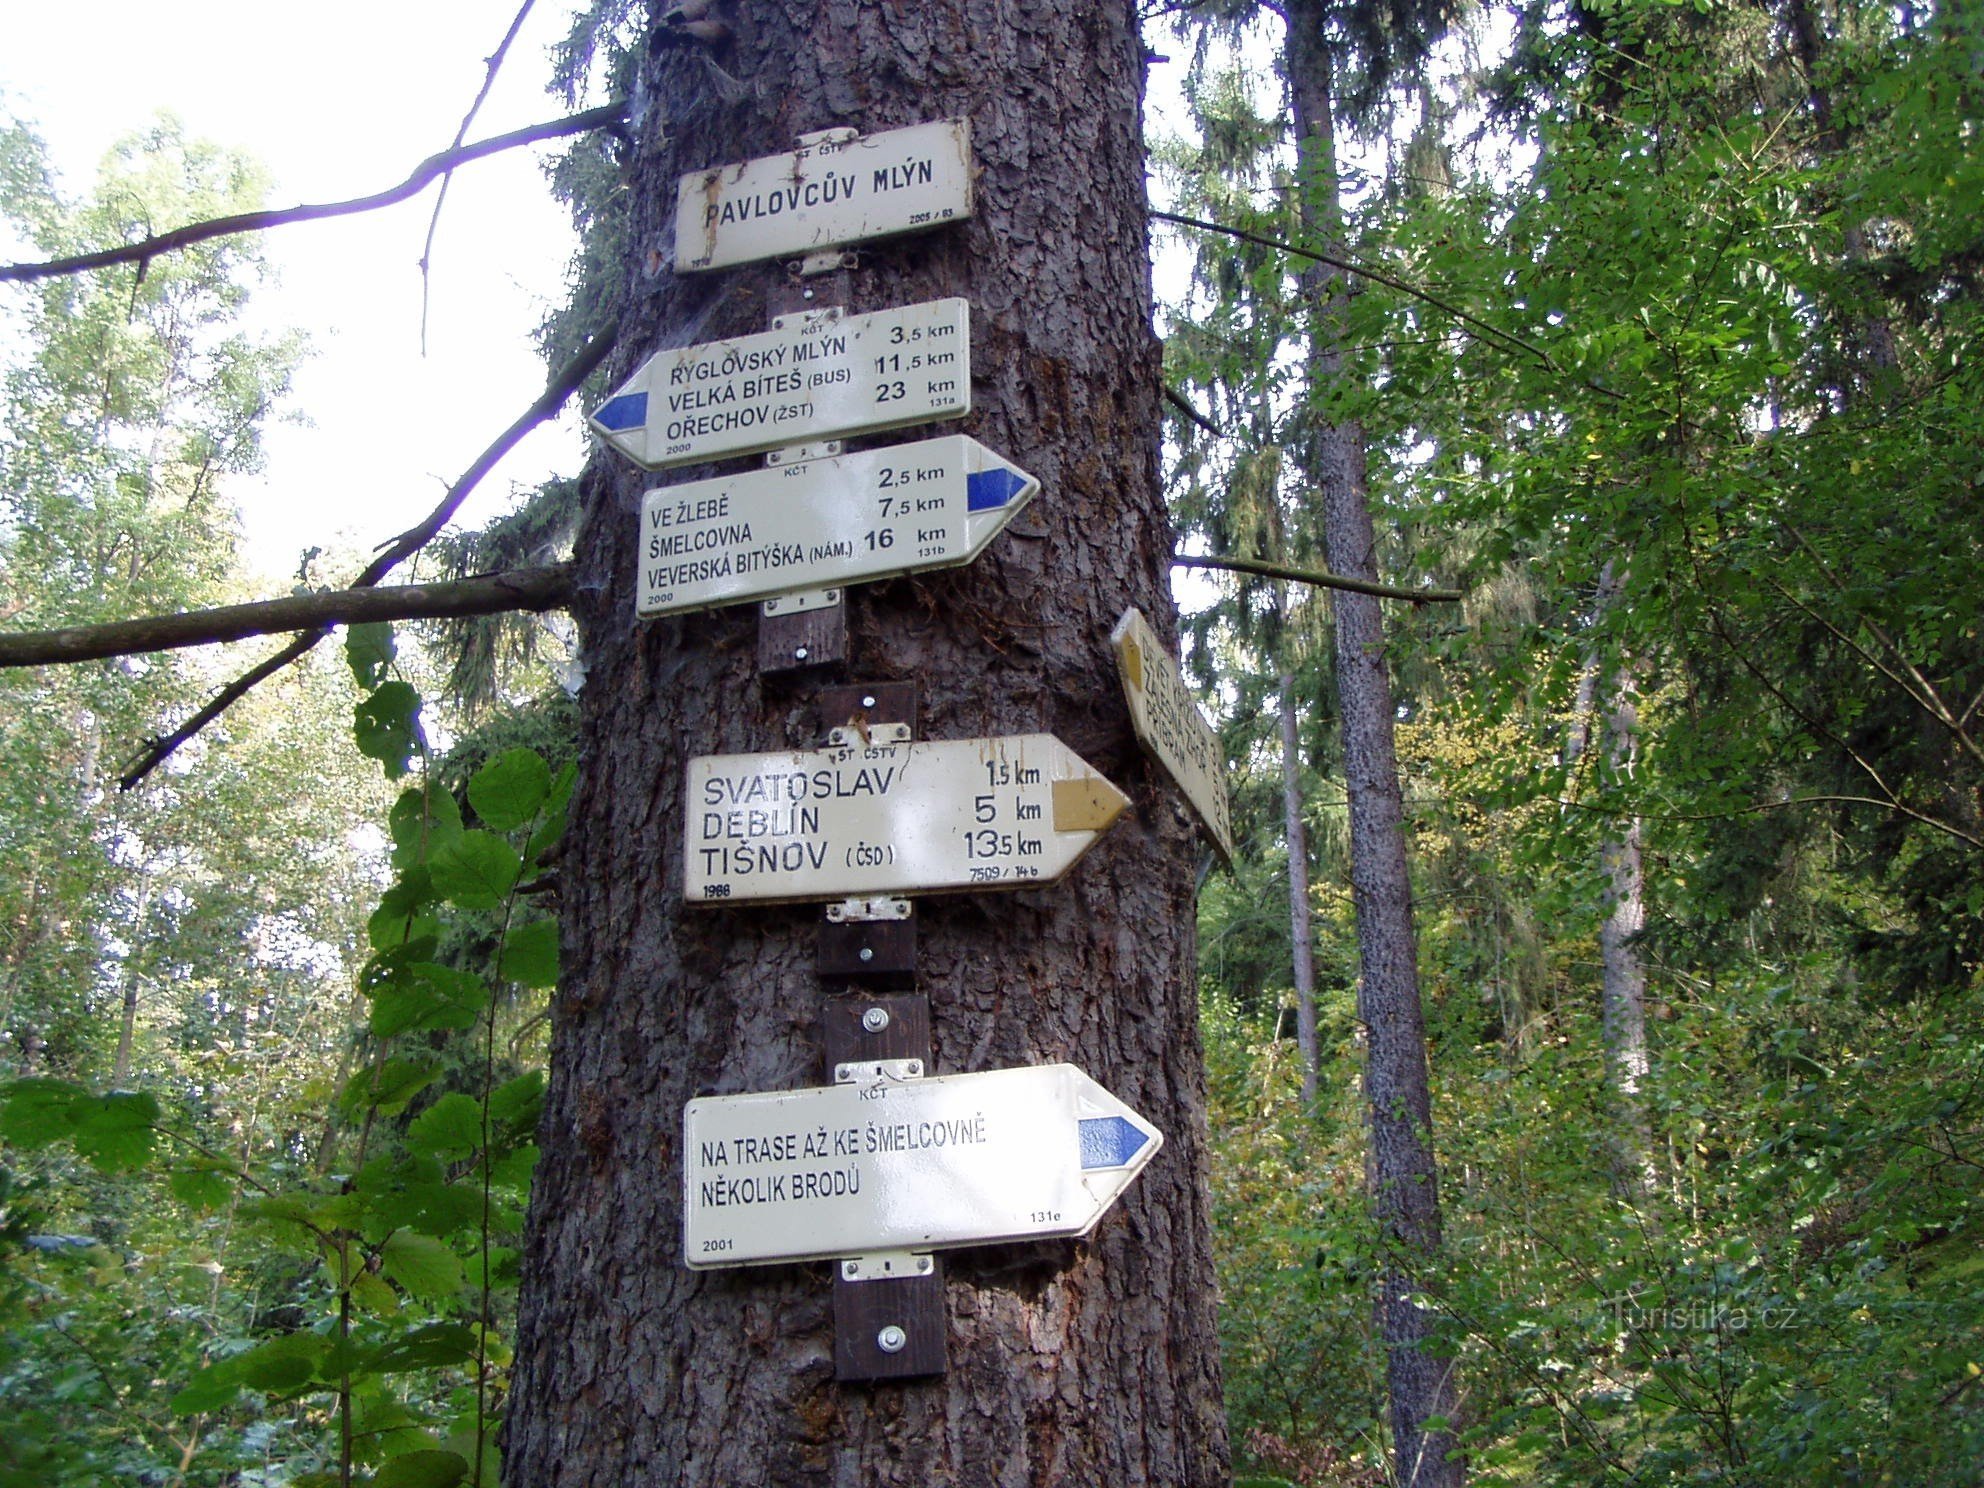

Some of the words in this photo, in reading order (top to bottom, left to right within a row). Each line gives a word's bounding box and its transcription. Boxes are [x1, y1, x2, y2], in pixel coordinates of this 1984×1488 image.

[706, 172, 856, 227] PAVLOVCŮV
[873, 157, 932, 193] MLÝN
[890, 326, 922, 345] 3,5
[928, 324, 955, 339] km
[792, 335, 846, 364] MLÝN
[876, 353, 922, 375] 11,5
[928, 351, 955, 367] km
[669, 379, 736, 413] VELKÁ
[743, 368, 802, 400] BÍTEŠ
[807, 367, 851, 391] (BUS)
[876, 381, 906, 403] 23
[928, 380, 956, 394] km
[667, 404, 770, 441] OŘECHOV
[773, 402, 814, 425] (ŽST)
[666, 443, 691, 455] 2000
[879, 468, 911, 489] 2,5
[917, 466, 945, 482] km
[651, 507, 672, 529] VE
[676, 492, 729, 525] ŽLEBĚ
[879, 498, 911, 519] 7,5
[917, 497, 945, 513] km
[649, 522, 753, 560] ŠMELCOVNA
[864, 528, 894, 551] 16
[917, 527, 946, 543] km
[918, 546, 945, 558] 131b
[647, 552, 732, 590] VEVERSKÁ
[736, 542, 805, 575] BITÝŠKA
[809, 540, 853, 565] (NÁM.)
[648, 592, 674, 606] 2000
[704, 767, 895, 805] SVATOSLAV
[1015, 760, 1040, 785] km
[703, 801, 819, 840] DEBLÍN
[975, 795, 996, 824] 5
[1016, 796, 1041, 820] km
[1017, 831, 1042, 855] km
[699, 840, 828, 876] TIŠNOV
[969, 866, 1000, 882] 7509
[702, 1140, 728, 1168] NA
[734, 1134, 797, 1165] TRASE
[803, 1126, 828, 1160] AŽ
[834, 1128, 859, 1157] KE
[865, 1111, 987, 1154] ŠMELCOVNĚ
[702, 1174, 786, 1208] NĚKOLIK
[792, 1162, 860, 1200] BRODŮ
[703, 1239, 734, 1252] 2001
